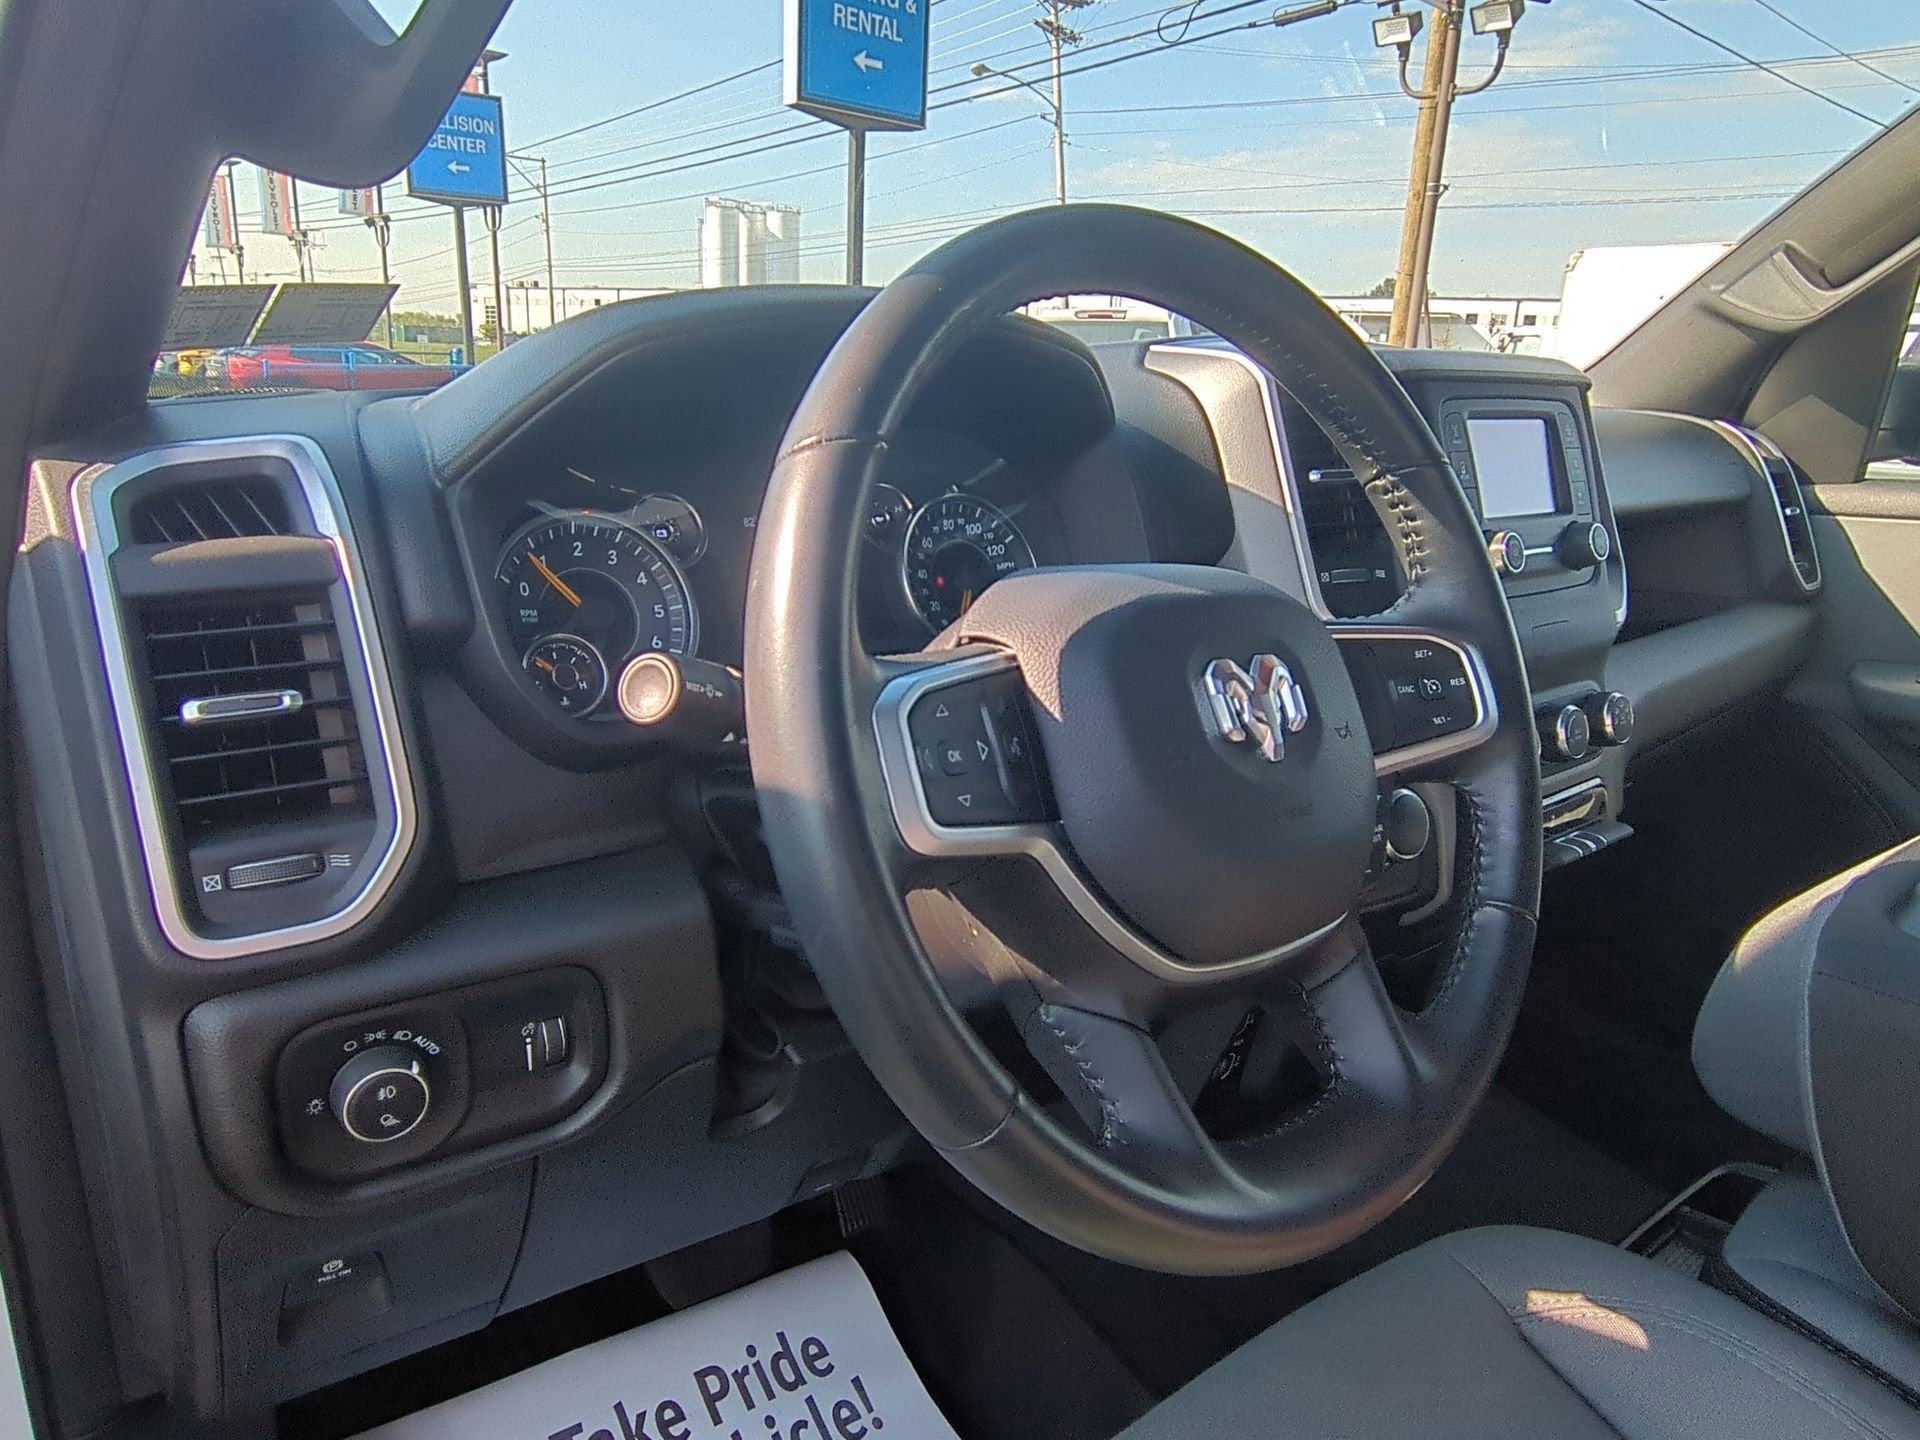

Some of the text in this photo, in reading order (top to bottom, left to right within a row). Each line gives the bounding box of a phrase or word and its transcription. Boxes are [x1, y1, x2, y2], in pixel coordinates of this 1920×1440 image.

[833, 3, 904, 43] RENTAL
[439, 114, 495, 135] LISION
[942, 519, 955, 530] 80
[965, 522, 982, 536] 100
[573, 541, 583, 557] 2
[922, 537, 933, 549] 60
[608, 550, 618, 565] 3
[987, 545, 1005, 557] 120
[996, 561, 1015, 571] MPH
[636, 572, 648, 585] 4
[519, 582, 530, 596] 0
[653, 605, 665, 618] 5
[930, 600, 940, 611] 20
[652, 635, 662, 648] 6
[1450, 677, 1466, 687] RES
[947, 750, 962, 763] OK
[413, 1035, 440, 1055] AUTO
[693, 1331, 835, 1427] Pride
